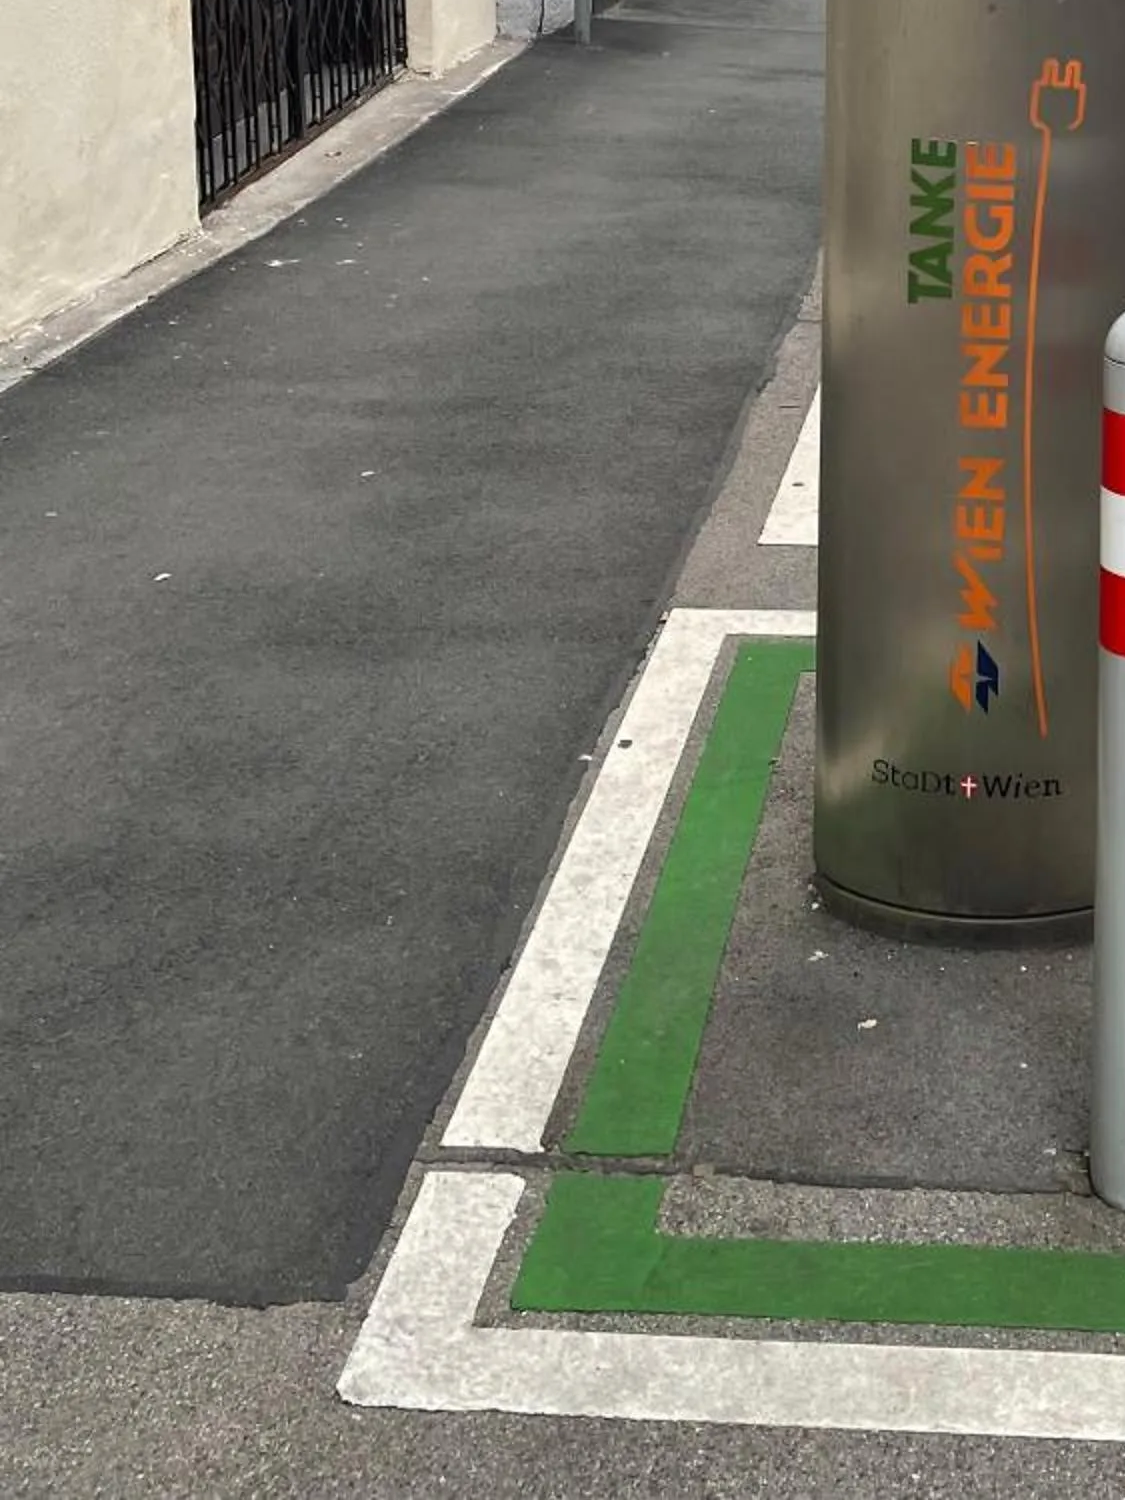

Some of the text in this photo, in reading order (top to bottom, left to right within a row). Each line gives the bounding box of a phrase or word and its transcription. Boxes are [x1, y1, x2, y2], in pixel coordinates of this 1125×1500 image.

[907, 137, 958, 305] TANKE
[954, 142, 1016, 631] WIEN ENERGIE
[981, 771, 1064, 799] Wien
